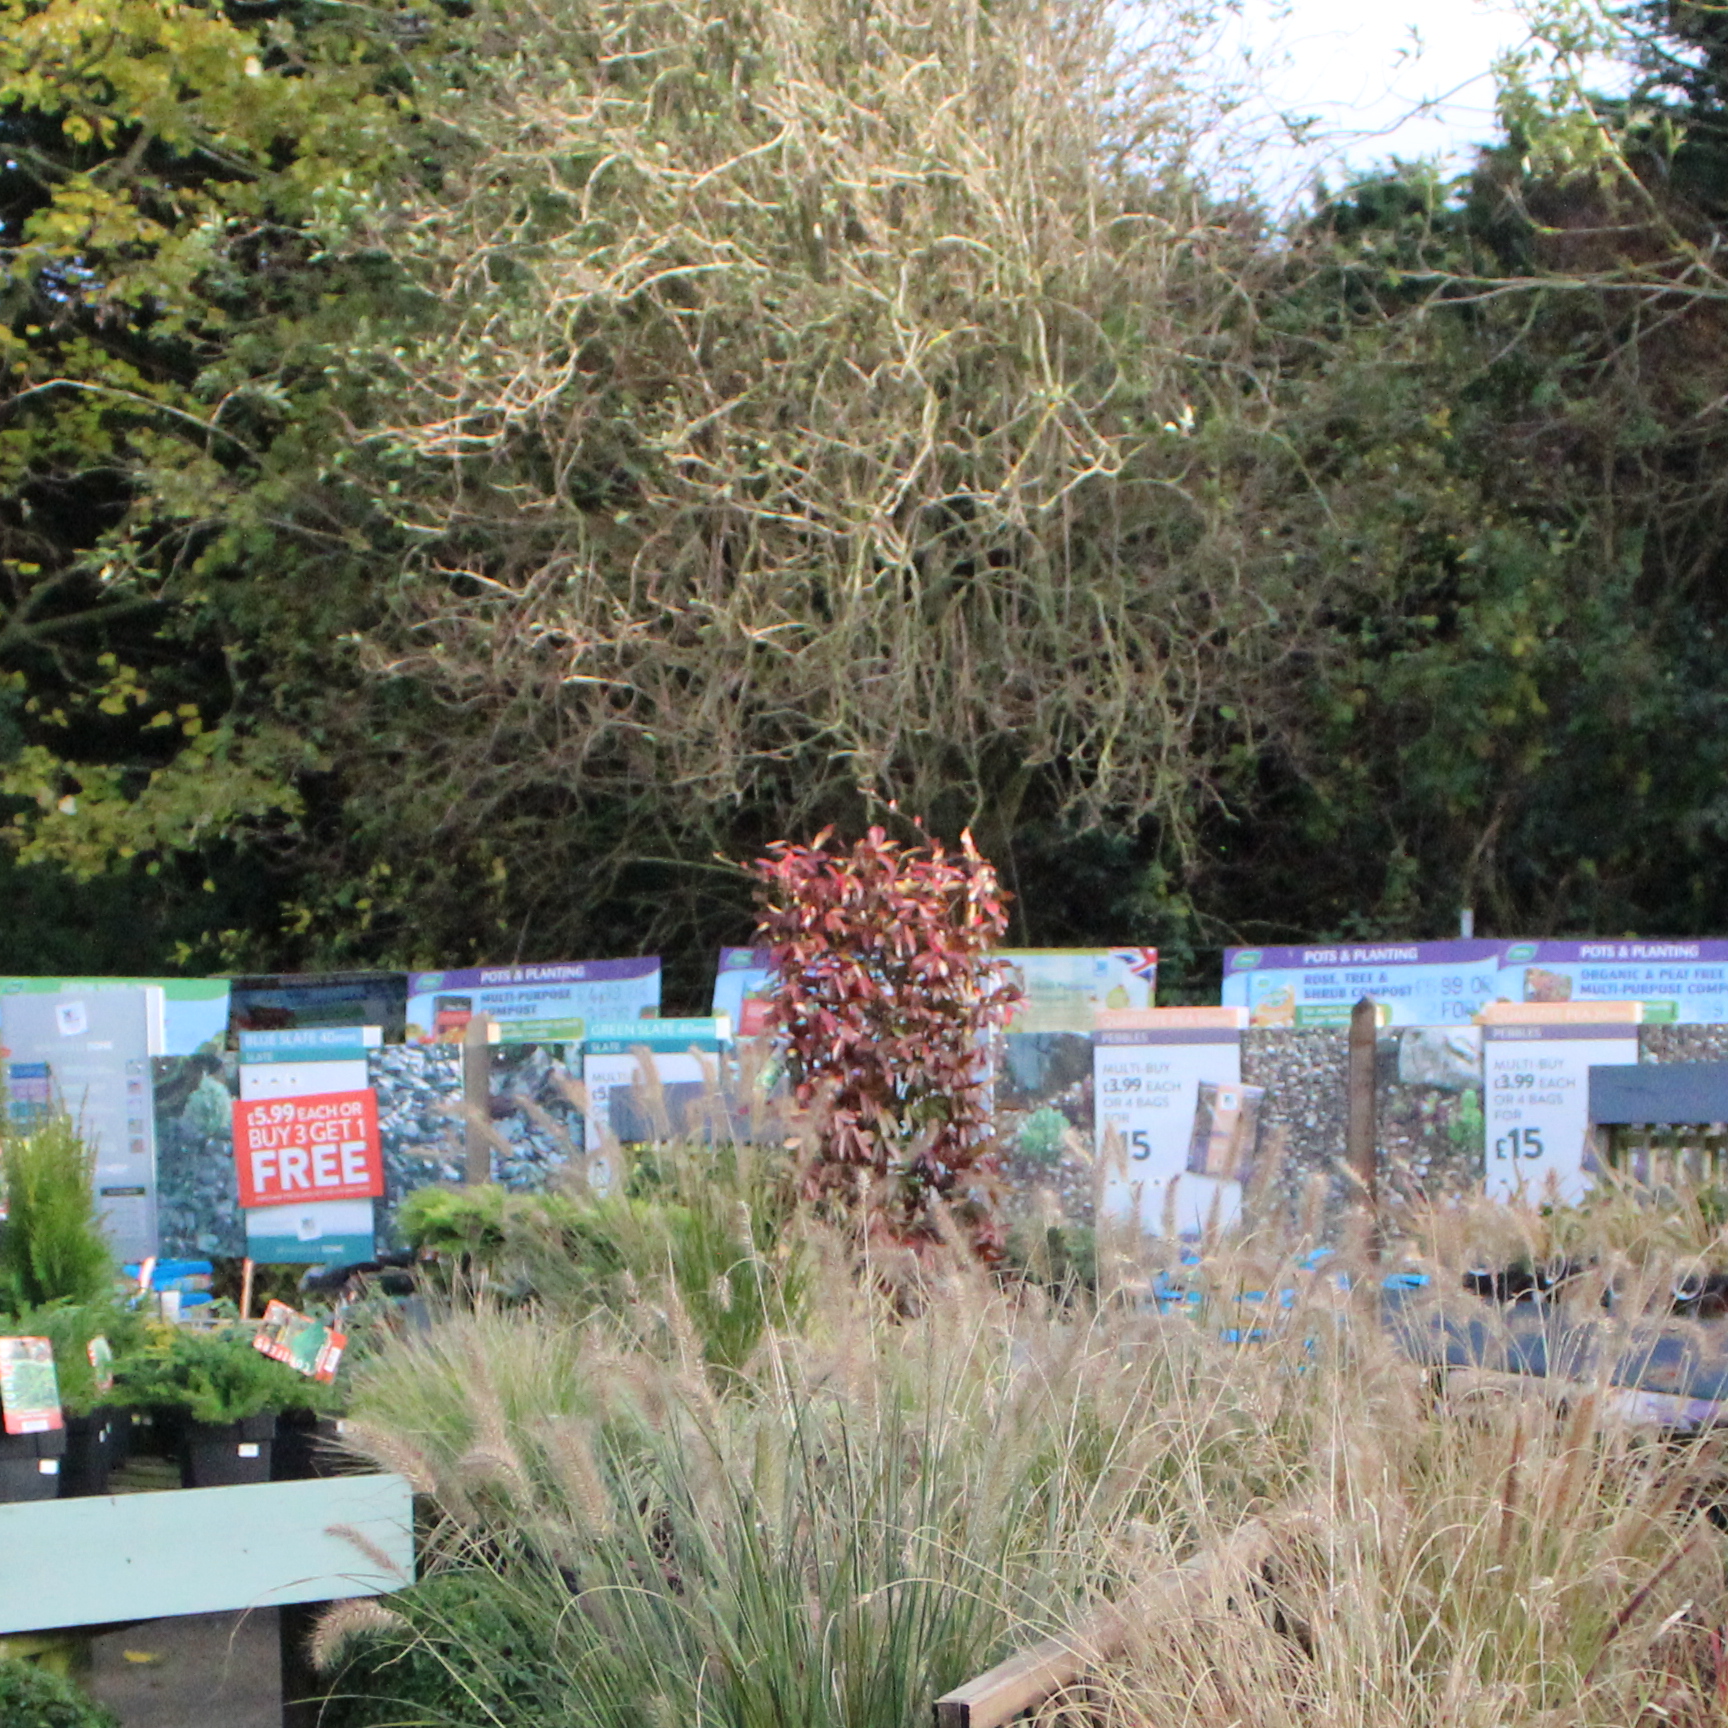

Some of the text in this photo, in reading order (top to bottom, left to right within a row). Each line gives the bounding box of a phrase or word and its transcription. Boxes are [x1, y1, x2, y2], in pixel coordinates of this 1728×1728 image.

[1303, 947, 1419, 963] POTS & PLANTING
[1580, 944, 1700, 959] POTS & PLANTING
[479, 963, 587, 985] POTS & PLANTING
[1344, 972, 1373, 984] TREE
[1378, 972, 1389, 984] &
[1580, 967, 1725, 981] ORGANIC & PEAT FREE
[480, 988, 571, 1004] MULTI-PURPOSE
[1303, 985, 1412, 999] SHRUB COMPOST
[1579, 982, 1682, 996] MULTI-PURPOSE
[590, 1023, 635, 1037] GREEN
[636, 1021, 675, 1036] SLATE
[244, 1031, 275, 1048] BLUE
[278, 1029, 318, 1046] SLATE
[590, 1041, 622, 1053] SLATE
[245, 1051, 274, 1063] SLATE
[1493, 1058, 1565, 1071] MULTI-BUY
[1102, 1062, 1171, 1076] MULTI-BUY
[1102, 1077, 1182, 1094] £3.99 EACH
[1493, 1074, 1576, 1090] £3.99 EACH
[1102, 1096, 1124, 1109] OR
[1136, 1095, 1170, 1109] BAGS
[1493, 1092, 1564, 1106] OR 4 BAGS
[246, 1101, 364, 1127] £5.99 EACH OR
[1494, 1109, 1523, 1121] FOR
[247, 1117, 367, 1150] BUY 3 GET 1
[1495, 1127, 1545, 1160] £15
[250, 1139, 371, 1194] FREE
[252, 1335, 312, 1374] CONIFERS
